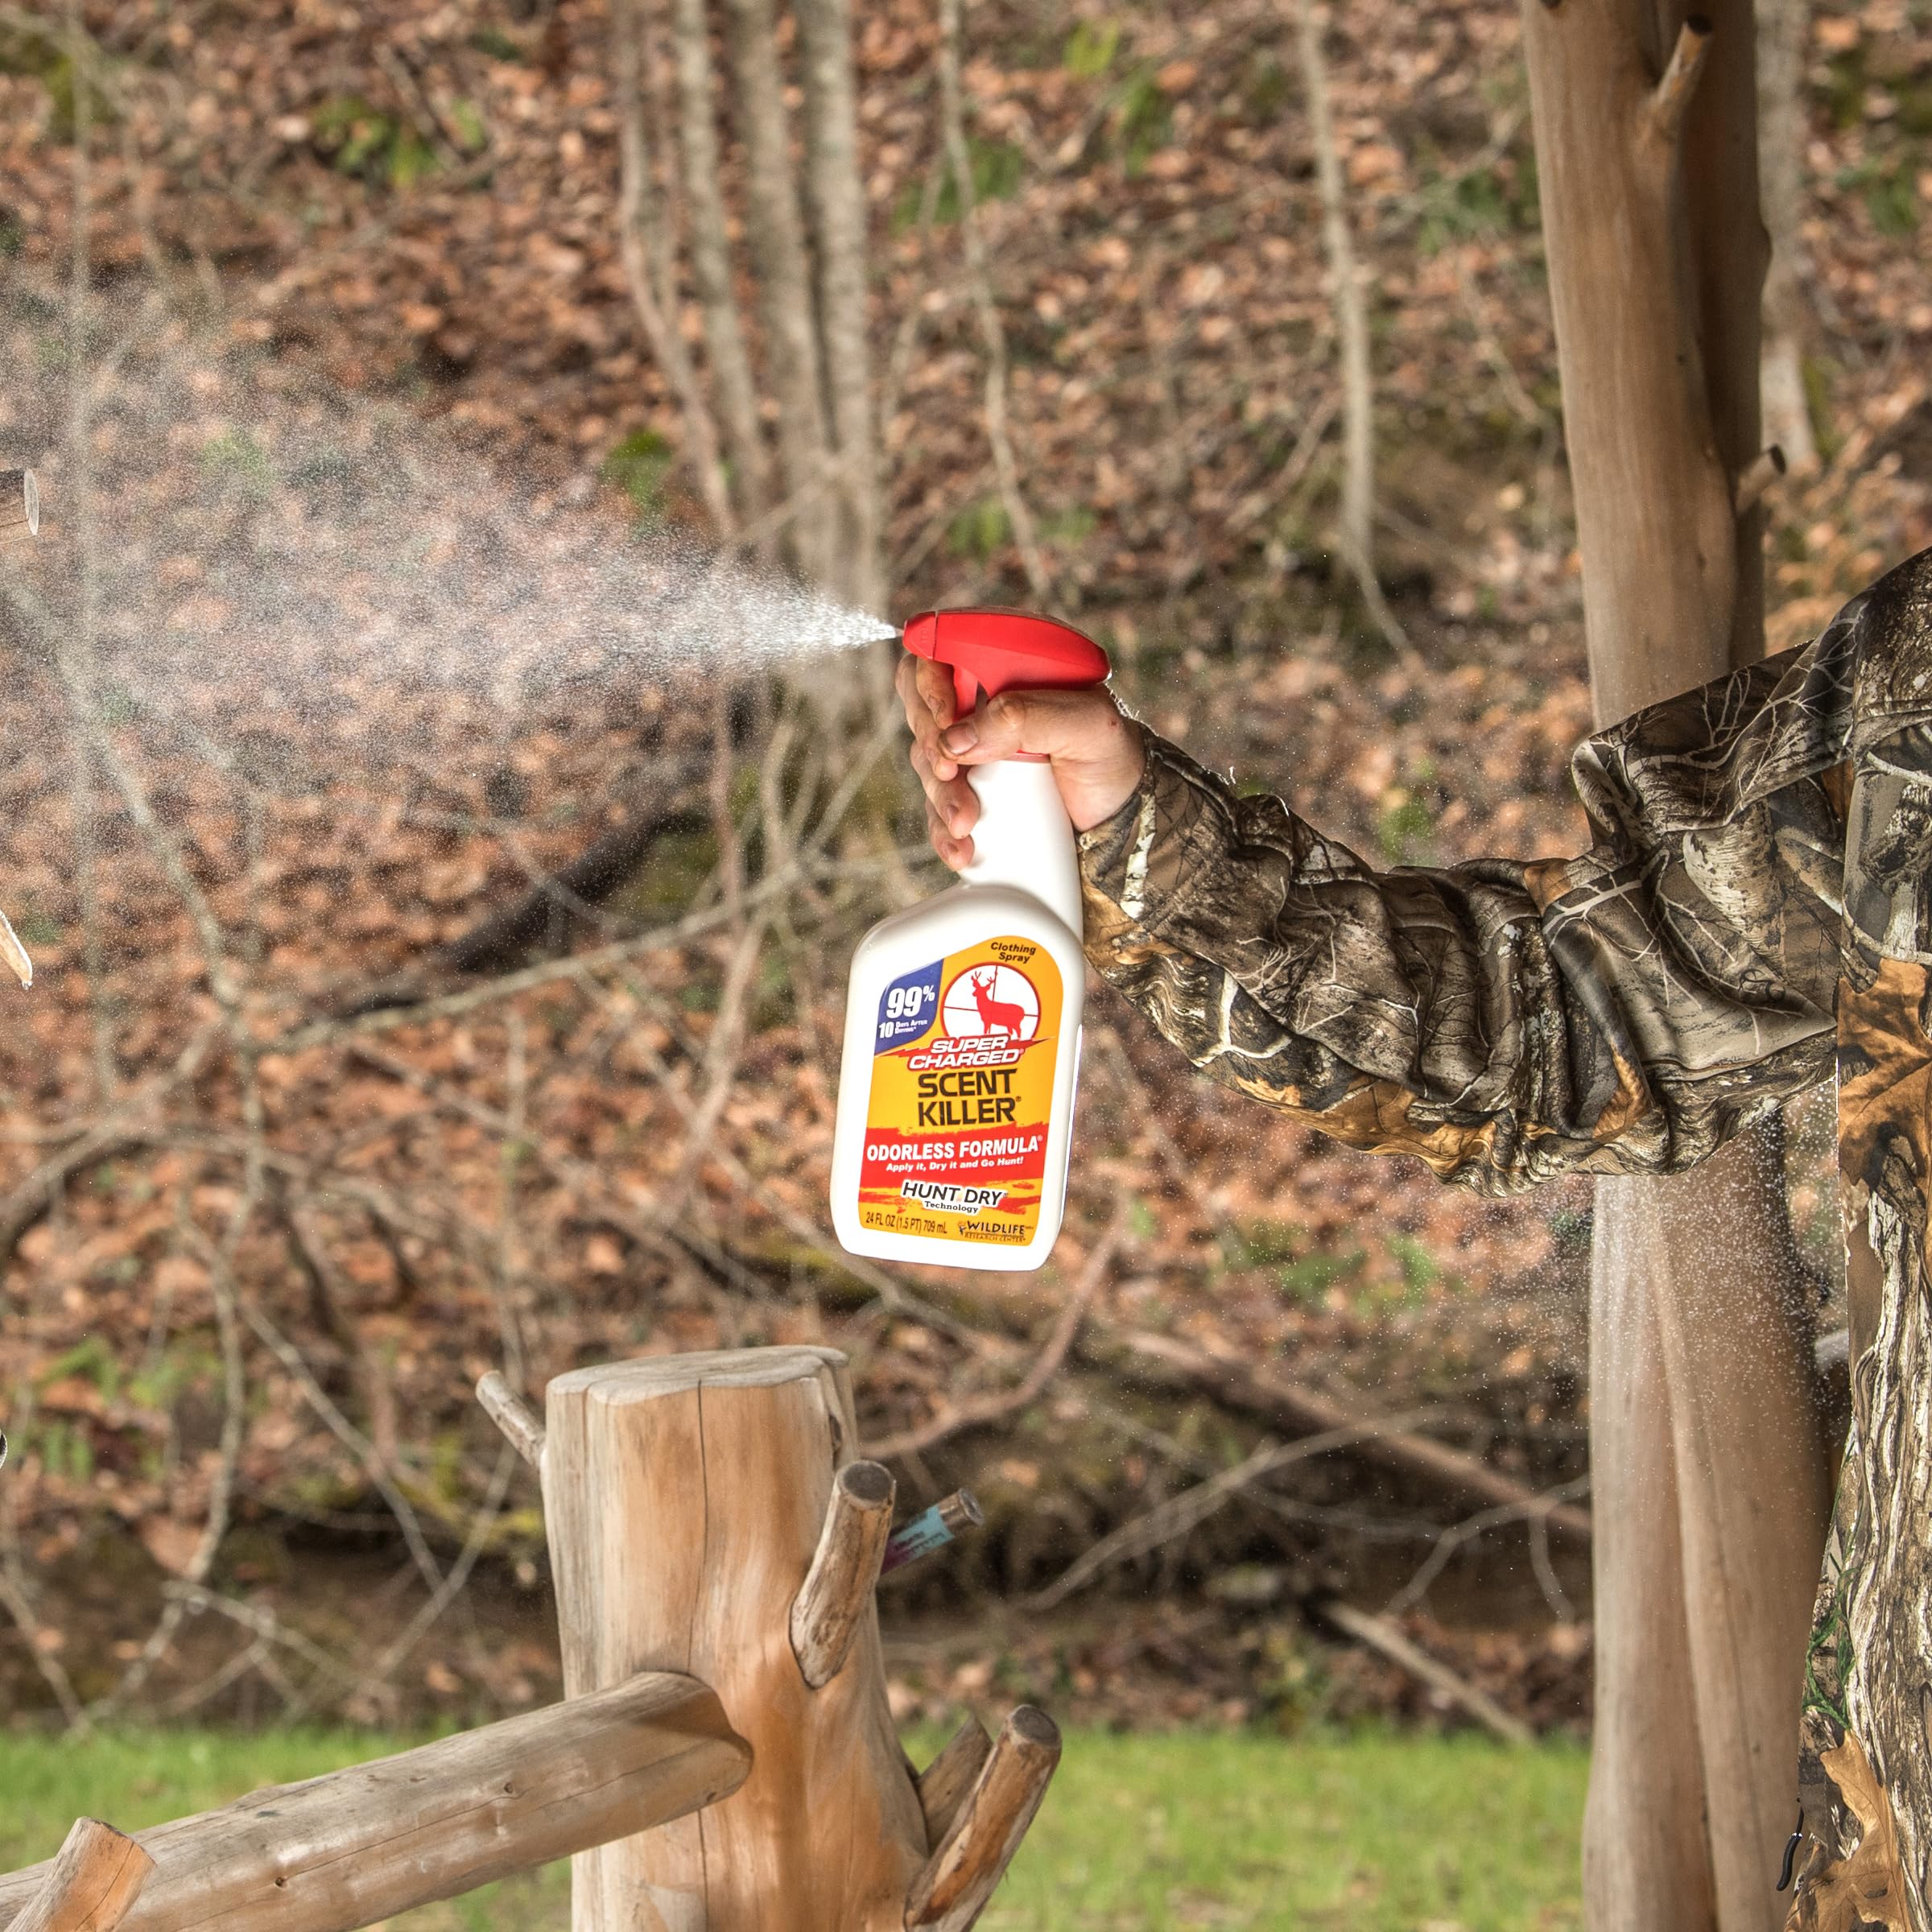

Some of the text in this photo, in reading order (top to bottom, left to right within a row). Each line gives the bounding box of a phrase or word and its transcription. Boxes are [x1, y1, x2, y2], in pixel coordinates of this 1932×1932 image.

[991, 942, 1036, 956] Clothing
[998, 952, 1030, 964] Spray
[886, 985, 935, 1018] 99%
[879, 1022, 894, 1038] 10
[931, 1036, 1009, 1054] SUPER
[909, 1049, 1019, 1069] CHARGED
[918, 1068, 1018, 1098] SCENT
[867, 1142, 955, 1161] ODORLESS
[886, 1156, 1024, 1173] Apply it, Dry it and Go Hunt!
[902, 1182, 1002, 1206] HUNT DRY
[924, 1200, 979, 1214] Technology
[866, 1211, 874, 1224] 24
[875, 1212, 883, 1225] FL
[886, 1214, 895, 1227] OZ
[923, 1219, 935, 1232] 709
[937, 1221, 947, 1234] mL
[967, 1220, 1025, 1235] WILDLIFE
